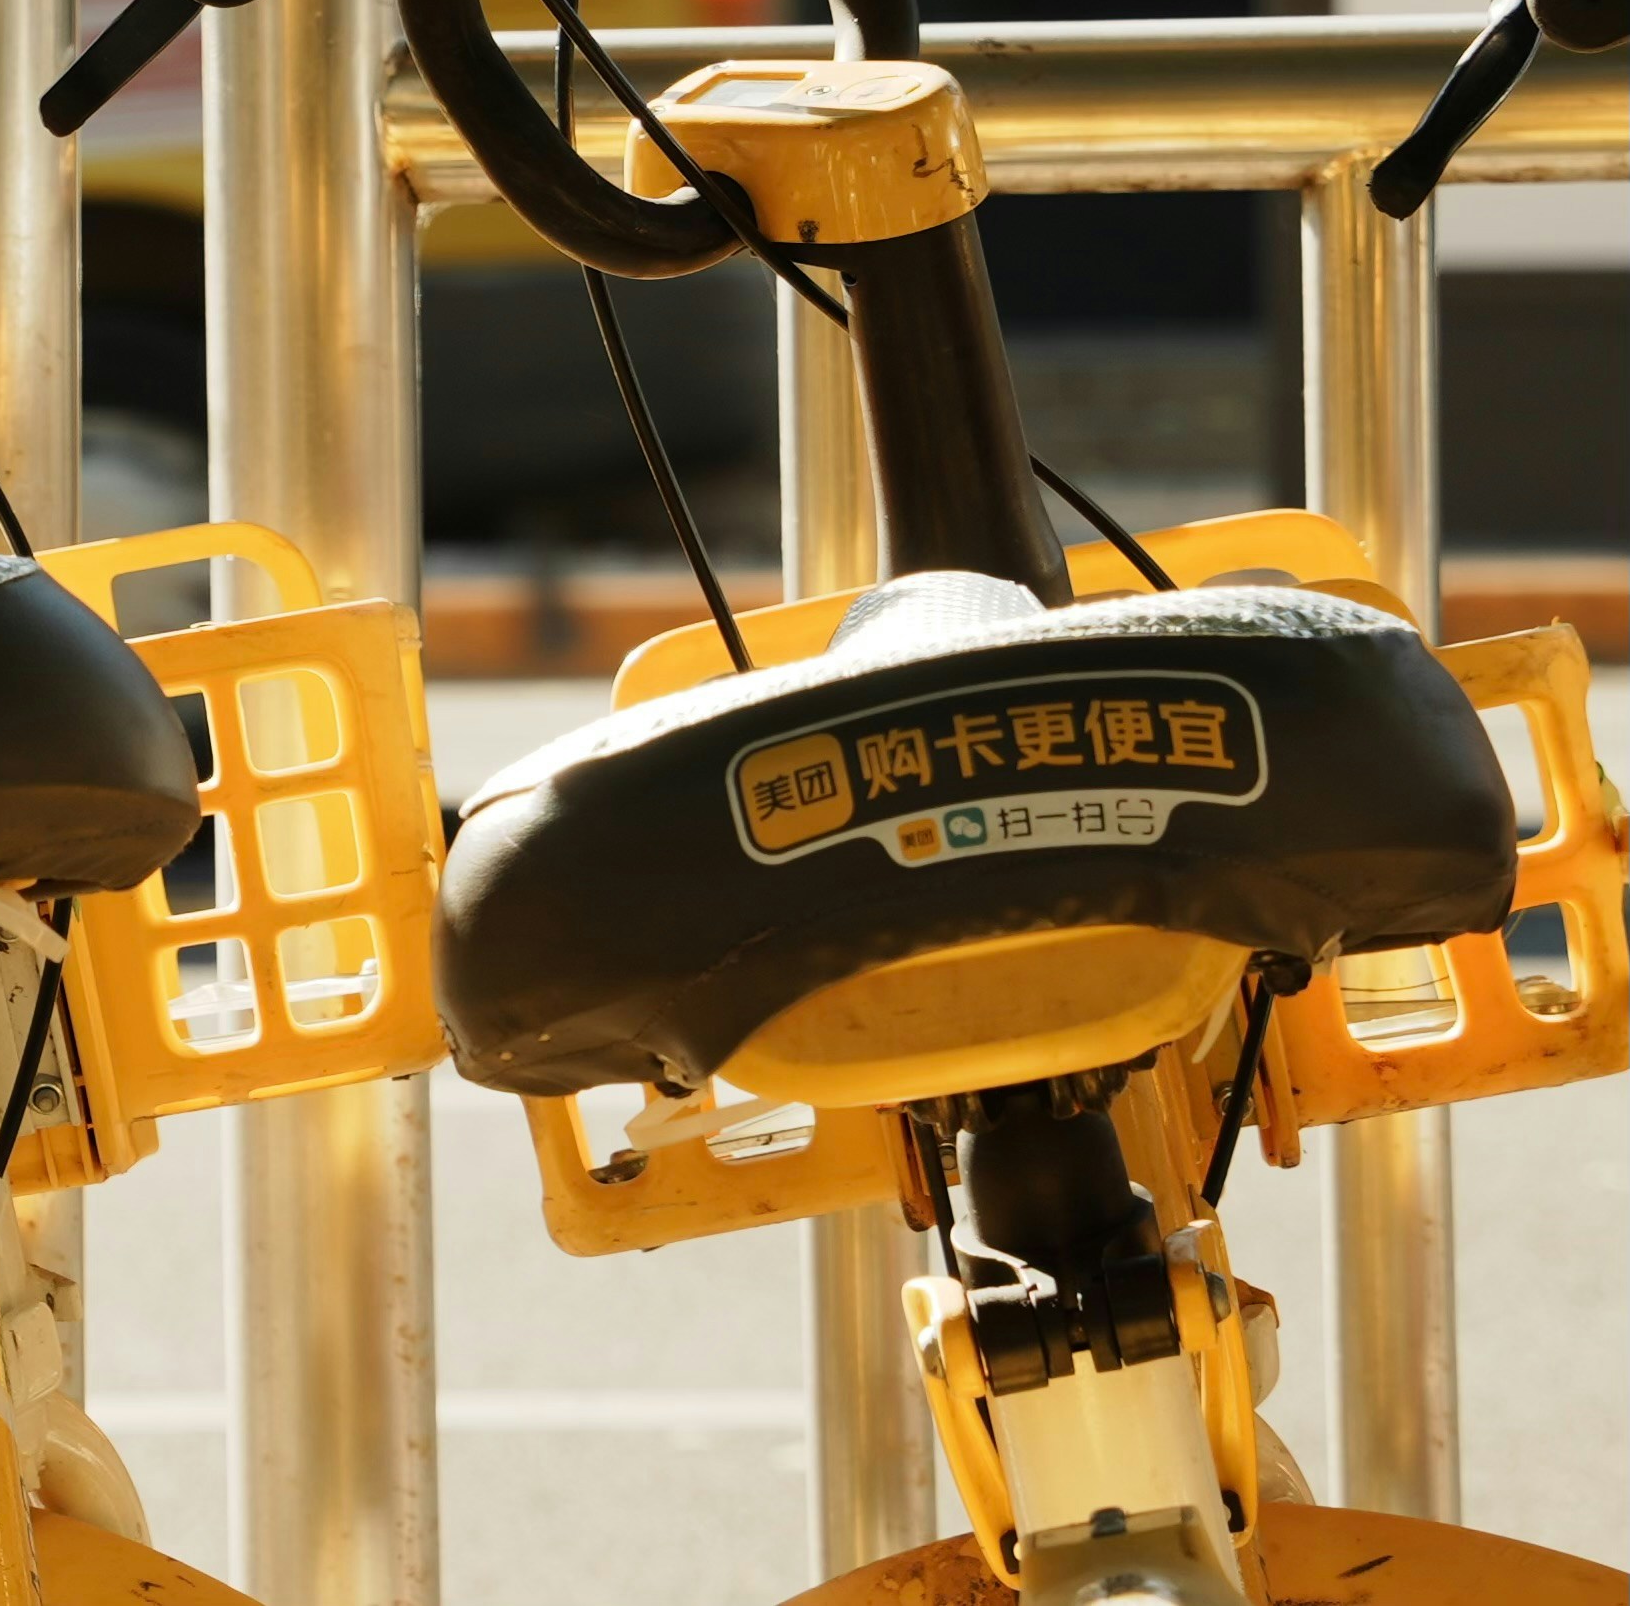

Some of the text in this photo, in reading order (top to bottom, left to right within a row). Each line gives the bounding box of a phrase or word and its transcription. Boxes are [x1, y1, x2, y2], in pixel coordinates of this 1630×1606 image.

[856, 699, 1235, 799] 购卡更便宜
[751, 759, 838, 821] 美团
[996, 801, 1106, 840] 扫一扫
